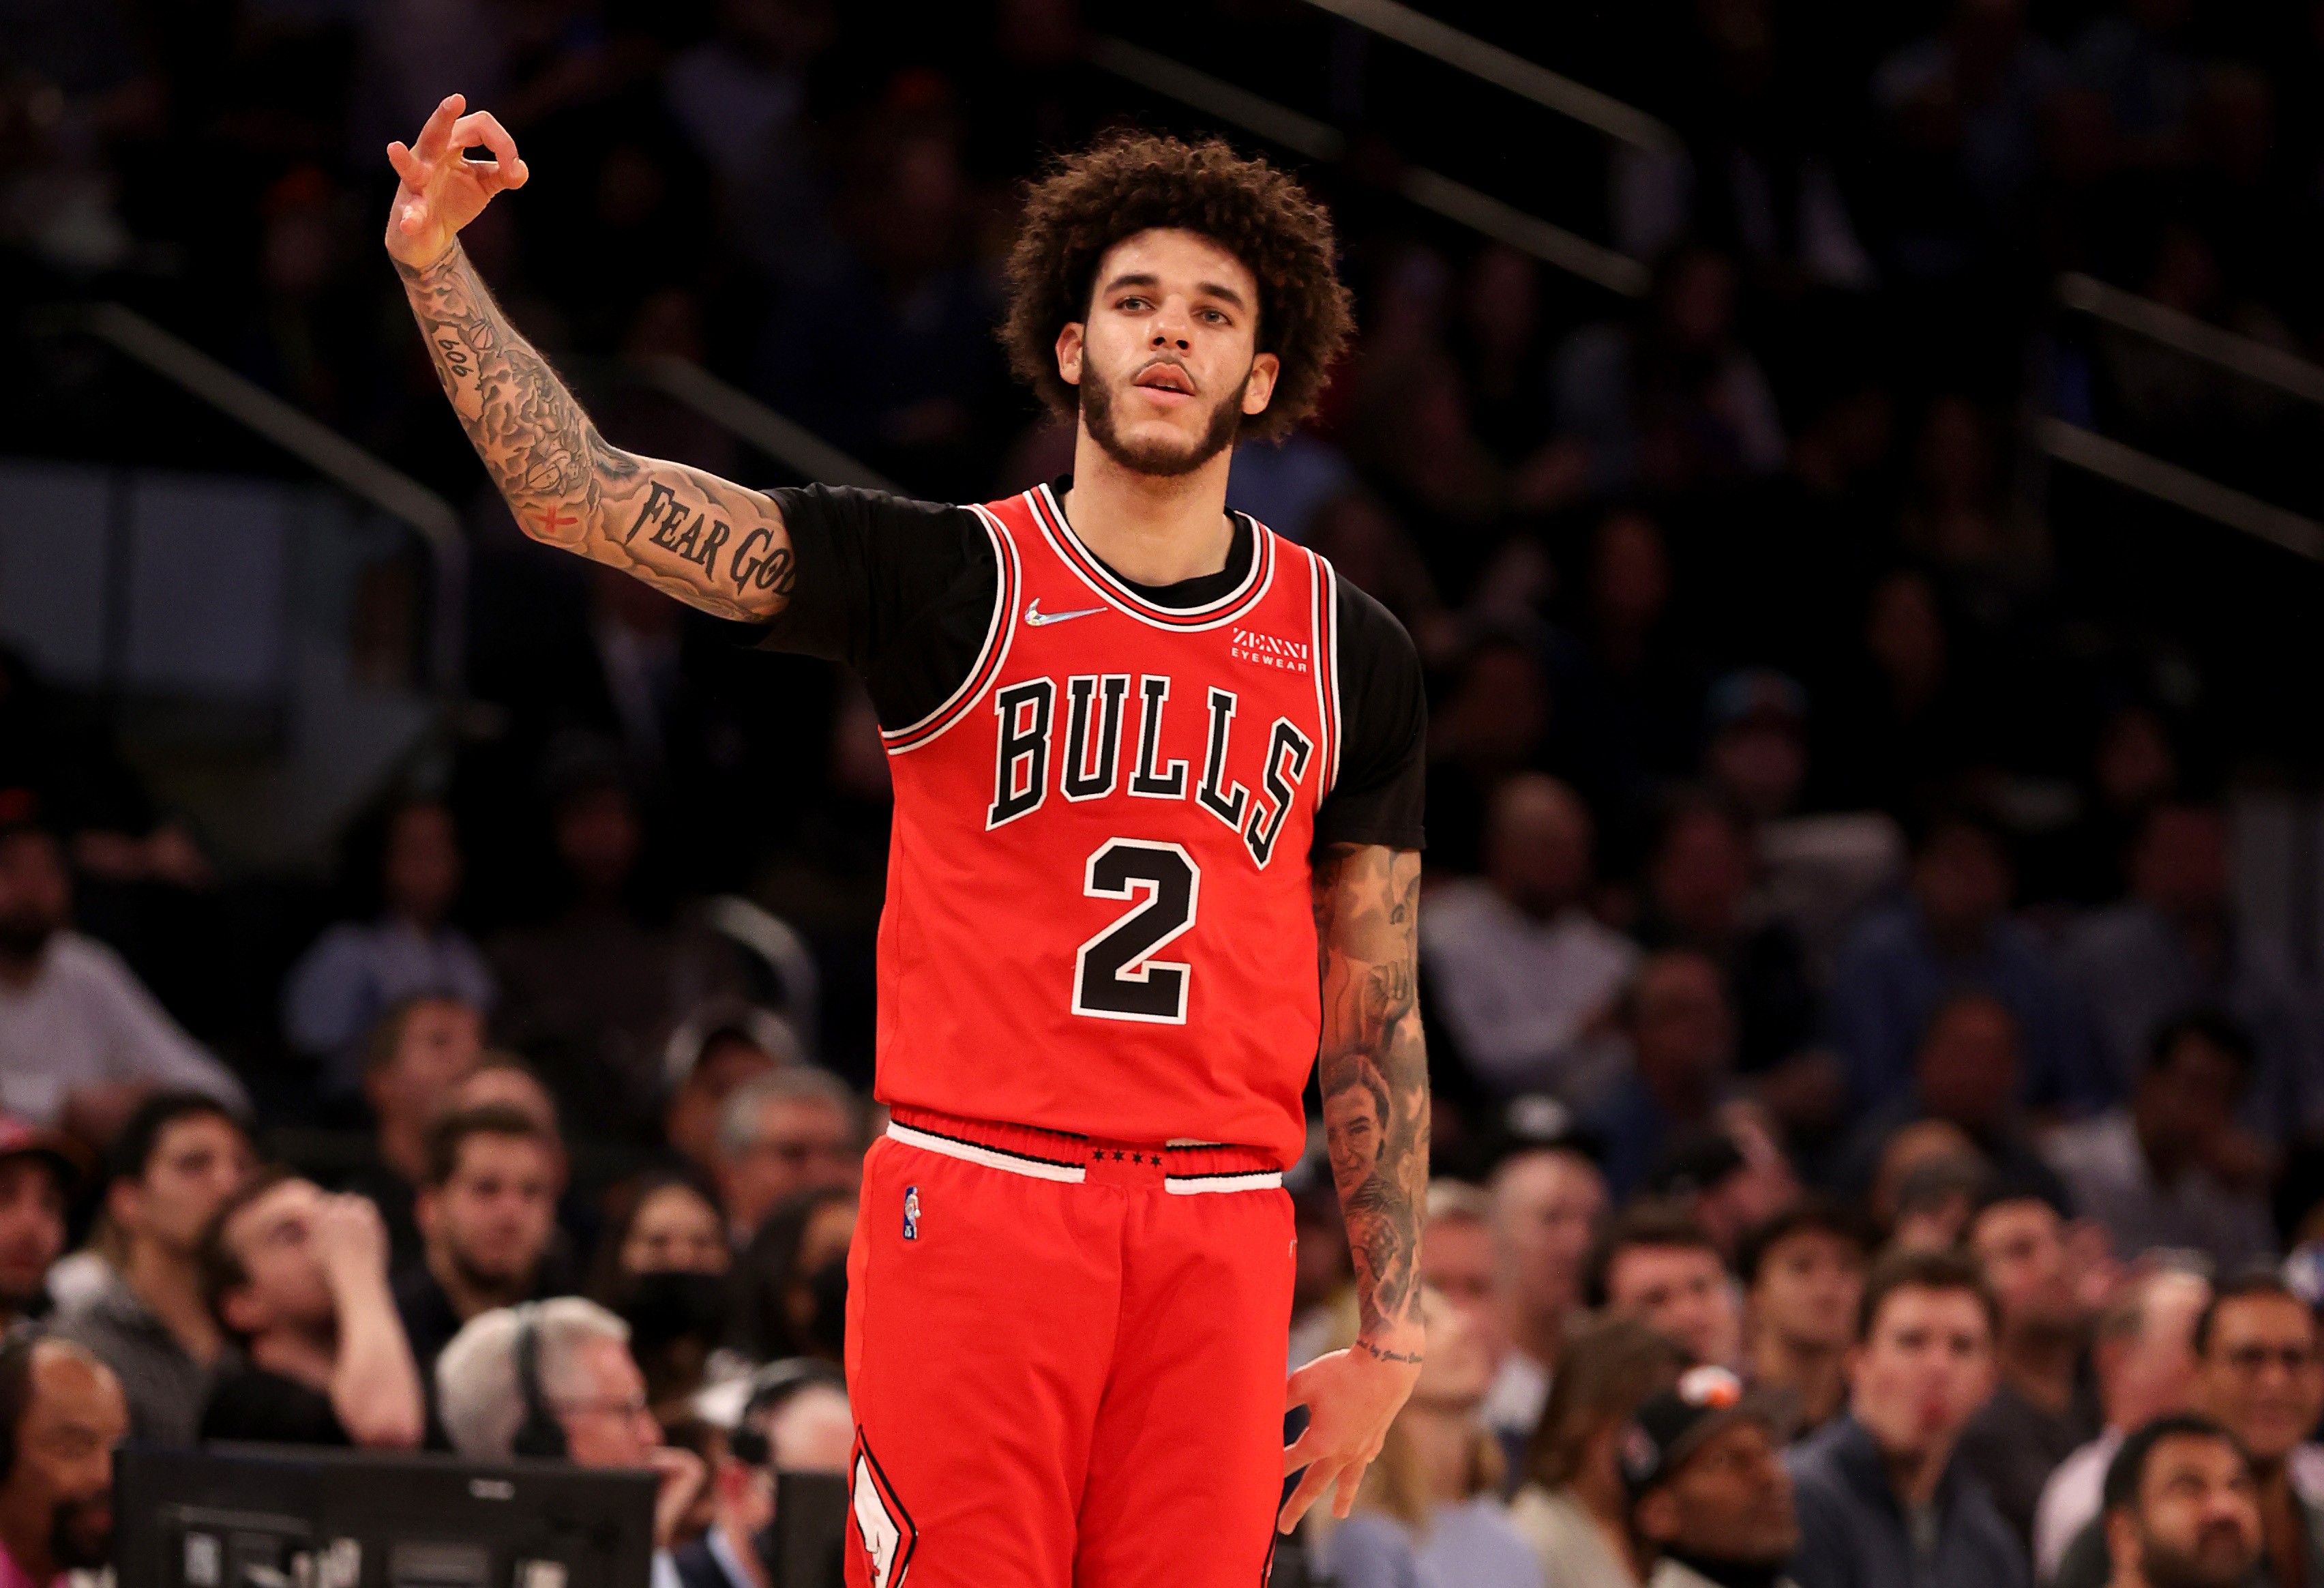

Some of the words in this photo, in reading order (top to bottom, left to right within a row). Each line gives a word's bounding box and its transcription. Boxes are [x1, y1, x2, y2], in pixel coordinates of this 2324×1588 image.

[625, 480, 730, 583] FEAR
[1232, 647, 1307, 673] EYEWEAR
[1233, 627, 1308, 660] ZENNI
[985, 674, 1314, 870] BULLS
[1071, 836, 1202, 1025] 2
